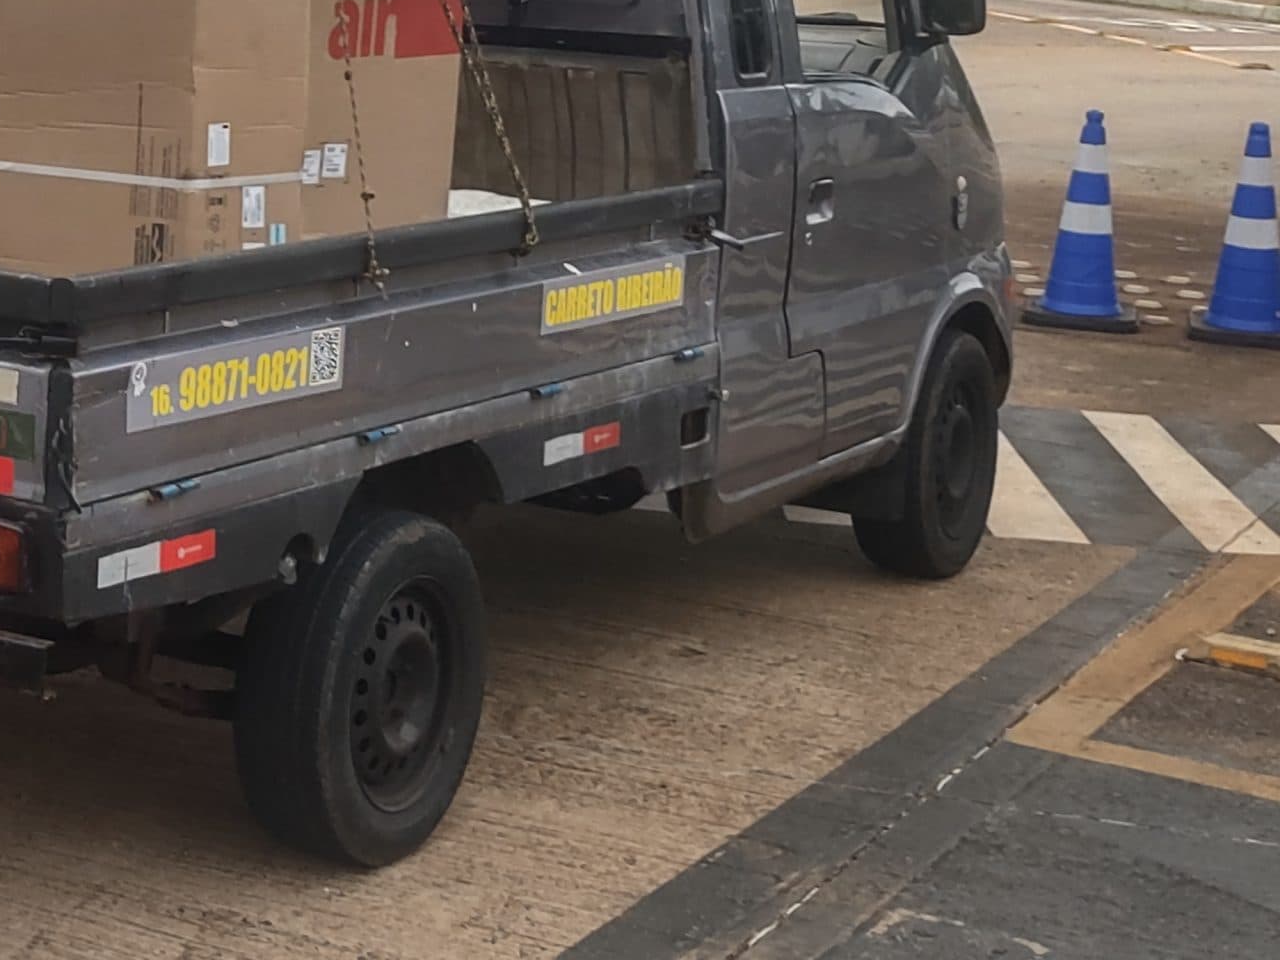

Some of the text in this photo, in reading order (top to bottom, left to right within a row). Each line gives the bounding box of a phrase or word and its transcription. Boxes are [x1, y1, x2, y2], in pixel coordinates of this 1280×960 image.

[545, 279, 614, 327] CARRETO
[150, 346, 308, 417] 16. 98871-0821
